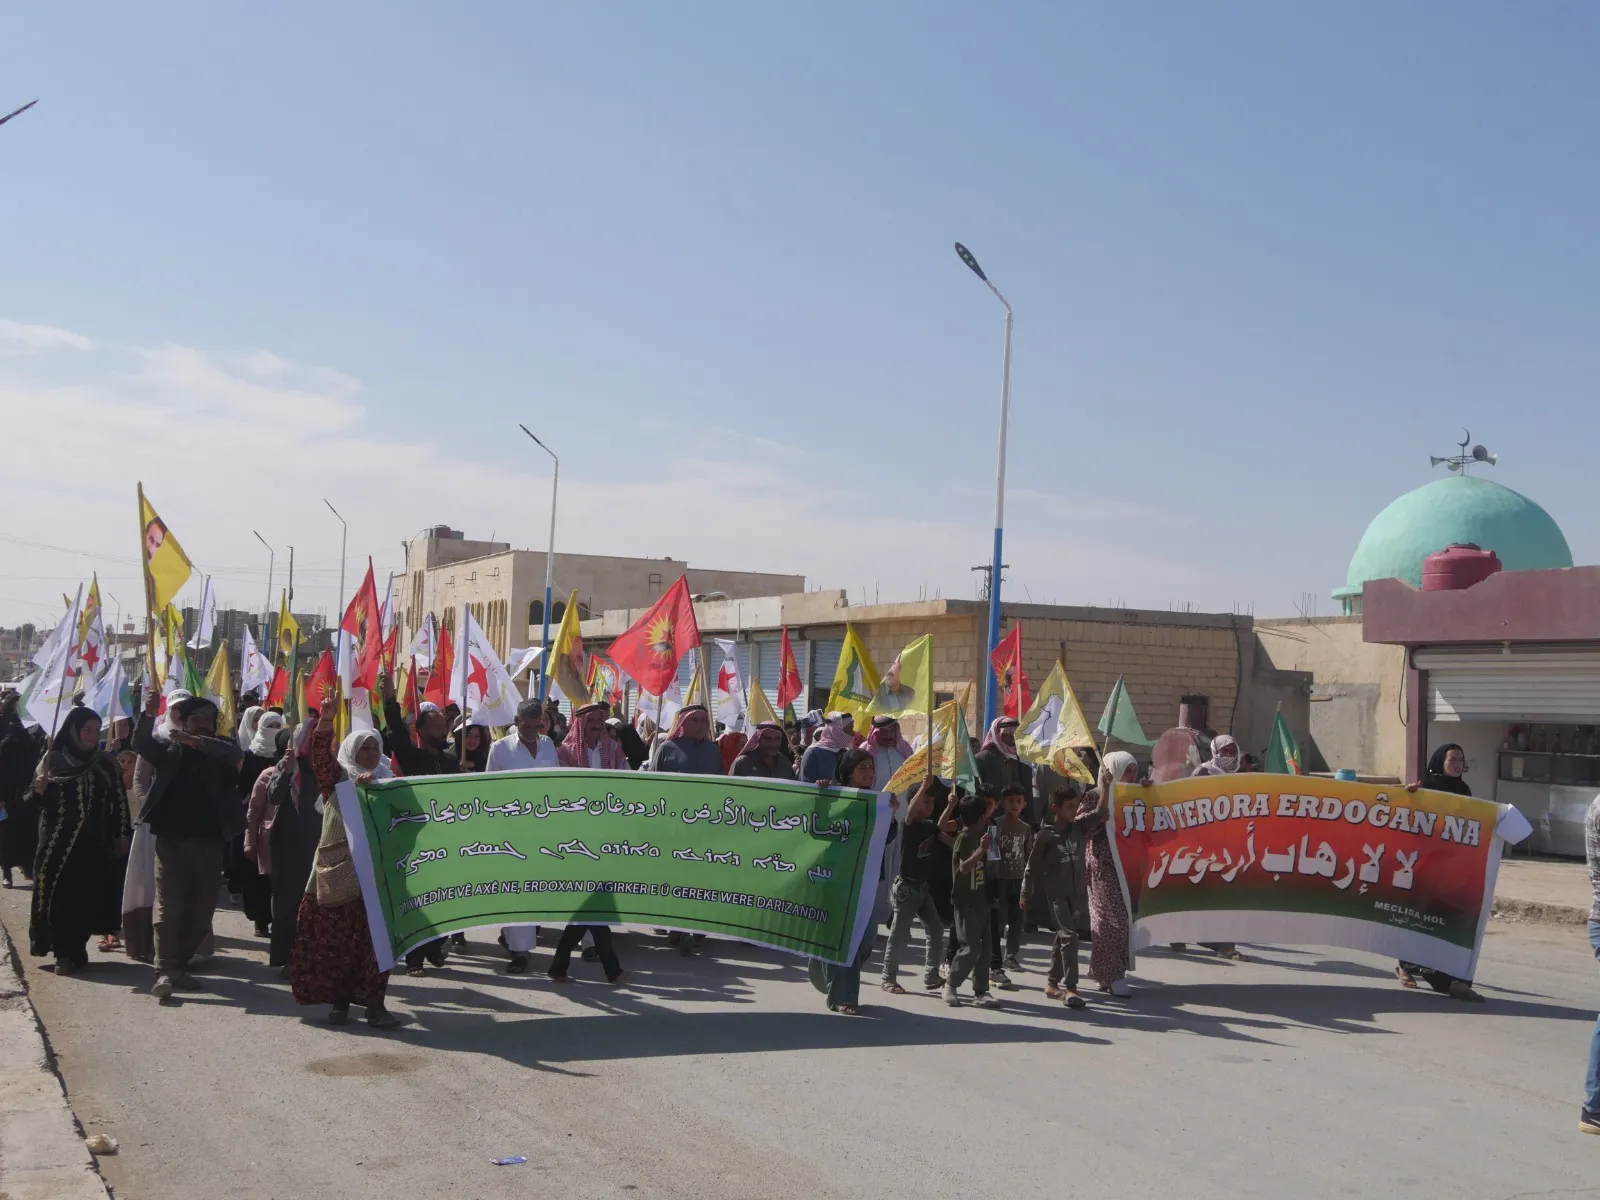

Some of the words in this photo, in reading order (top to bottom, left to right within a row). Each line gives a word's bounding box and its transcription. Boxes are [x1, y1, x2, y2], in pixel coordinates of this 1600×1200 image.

[457, 797, 481, 821] ان
[482, 798, 533, 818] ويجب
[534, 795, 588, 818] محتل
[587, 792, 666, 818] اردوغان
[749, 806, 809, 833] اصحاب
[811, 812, 850, 843] إننا
[1440, 815, 1481, 847] NA
[1147, 821, 1257, 889] أردوغان
[1261, 833, 1385, 896] لإرهاب
[1391, 848, 1420, 891] لا
[457, 882, 473, 898] VÊ
[474, 880, 499, 896] AXÊ
[501, 881, 520, 896] NE,
[523, 880, 584, 894] ERDOXAN
[586, 881, 648, 896] DAGIRKER
[650, 883, 658, 896] E
[660, 882, 670, 897] Û
[672, 886, 719, 903] GEREKE
[720, 891, 755, 907] WERE
[756, 896, 829, 924] DARIZANDIN
[1374, 900, 1421, 920] MECLISA
[1423, 913, 1446, 927] HOL
